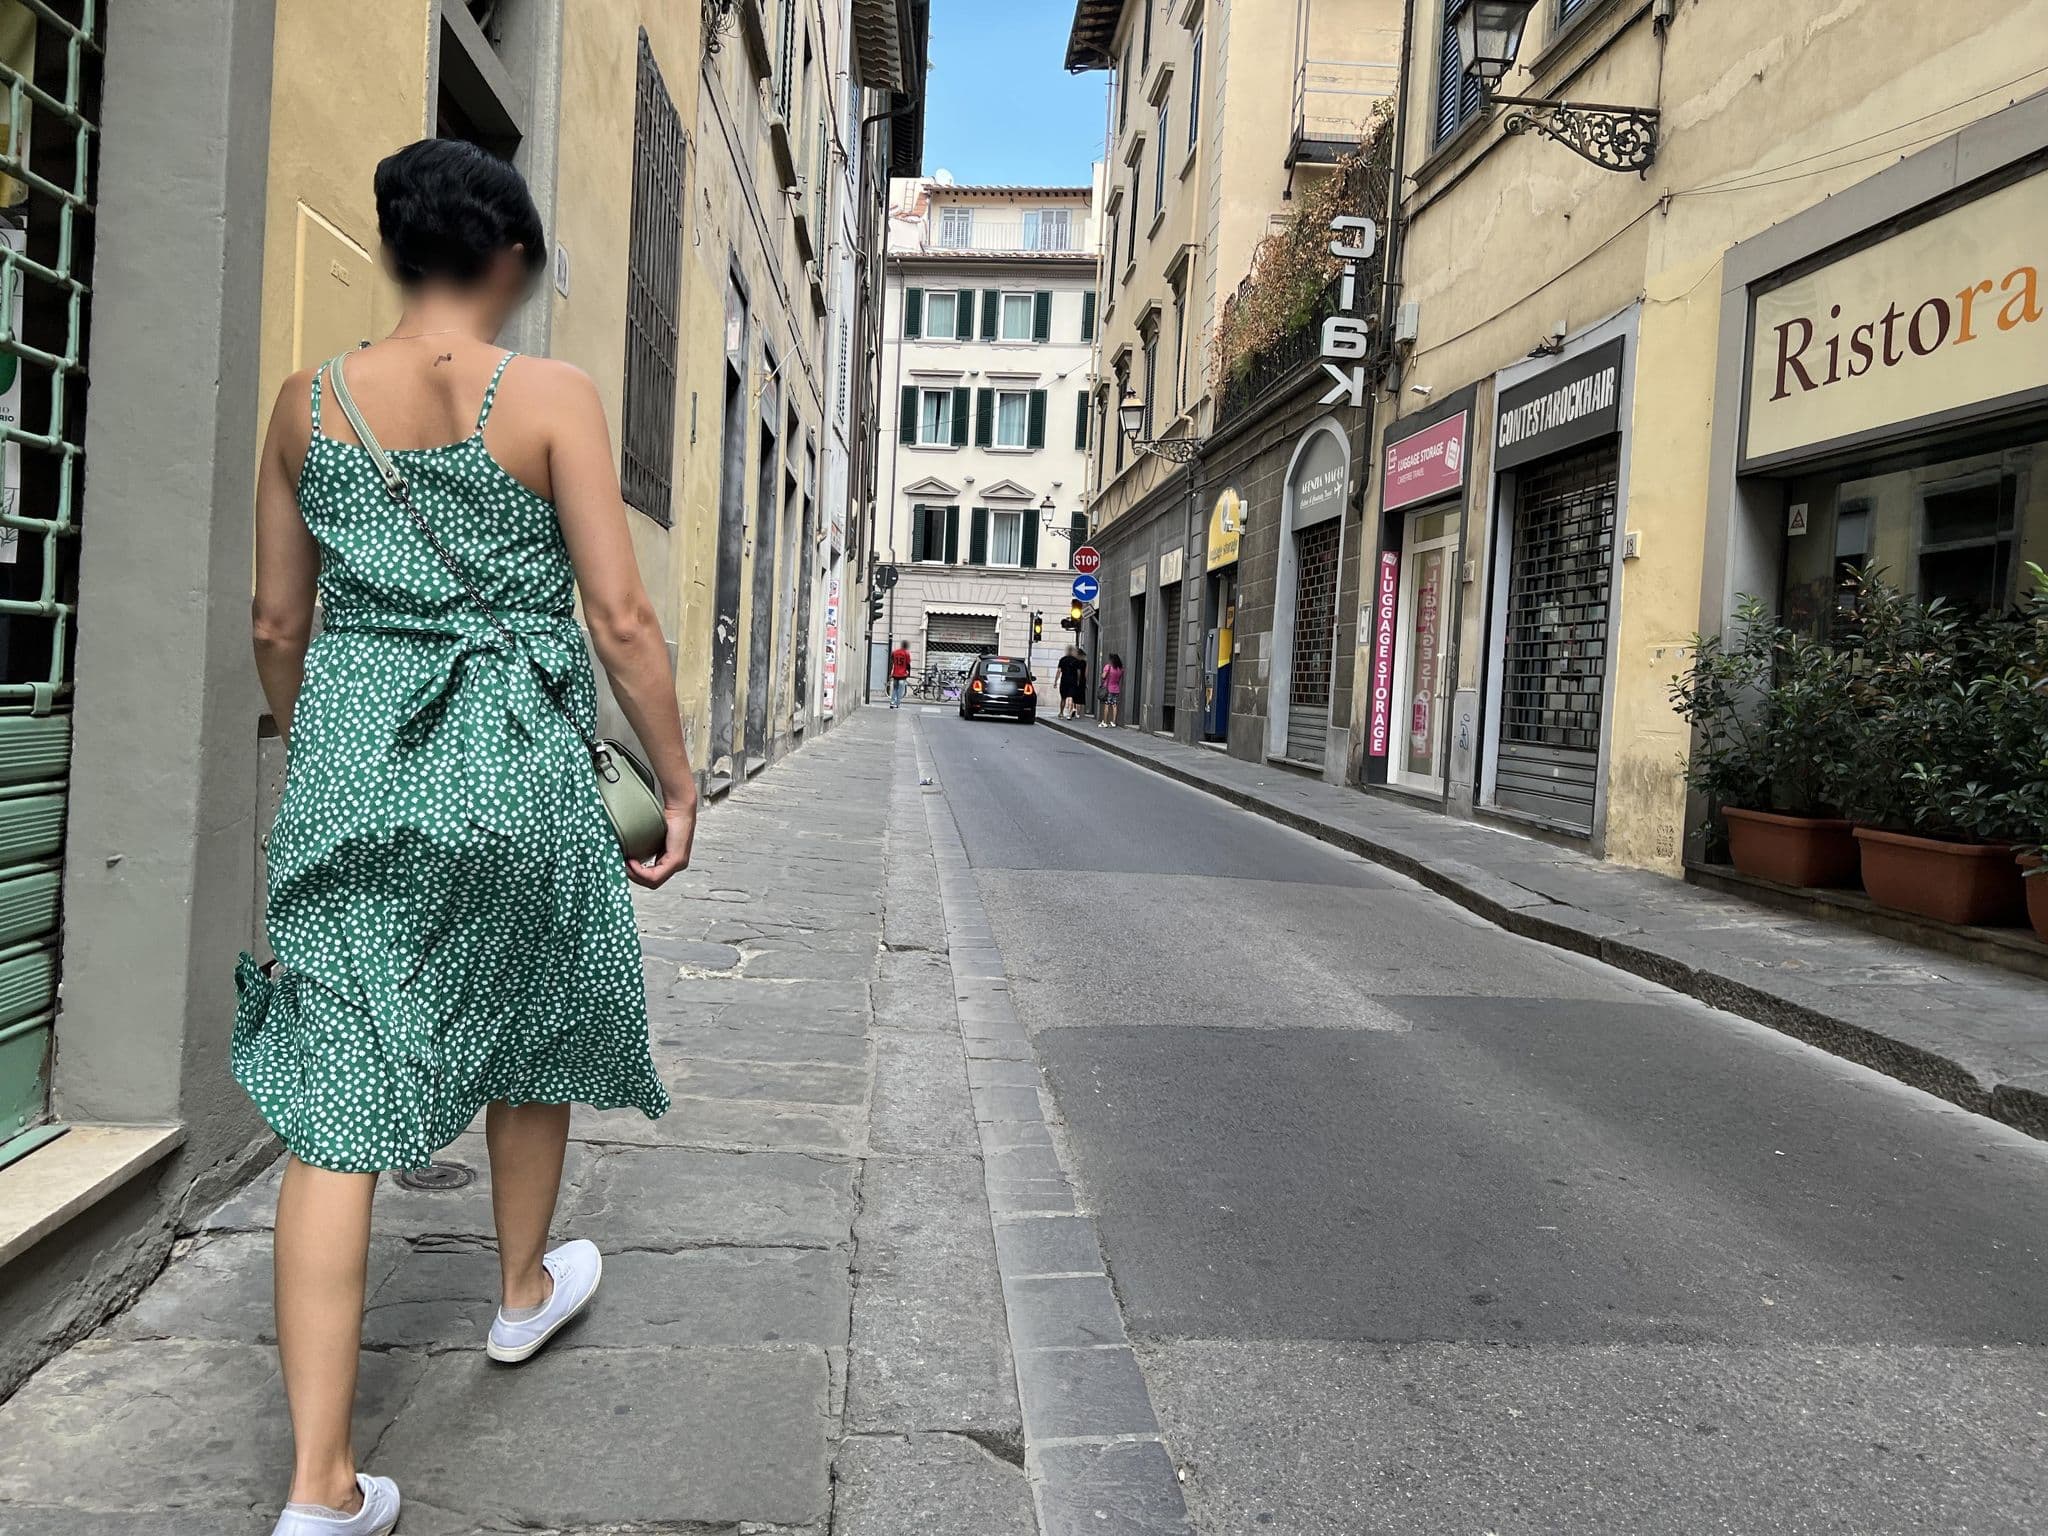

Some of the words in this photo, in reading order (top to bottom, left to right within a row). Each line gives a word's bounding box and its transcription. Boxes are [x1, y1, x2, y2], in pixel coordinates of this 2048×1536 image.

[1769, 265, 2044, 403] Ristora
[1498, 366, 1615, 448] CONTESTAROCKHAIR
[1397, 451, 1420, 472] LUGGAGE
[1420, 441, 1444, 462] STORAGE
[1075, 555, 1098, 566] STOP
[1379, 567, 1394, 658] LUGGAGE
[1373, 661, 1392, 752] STORAGE
